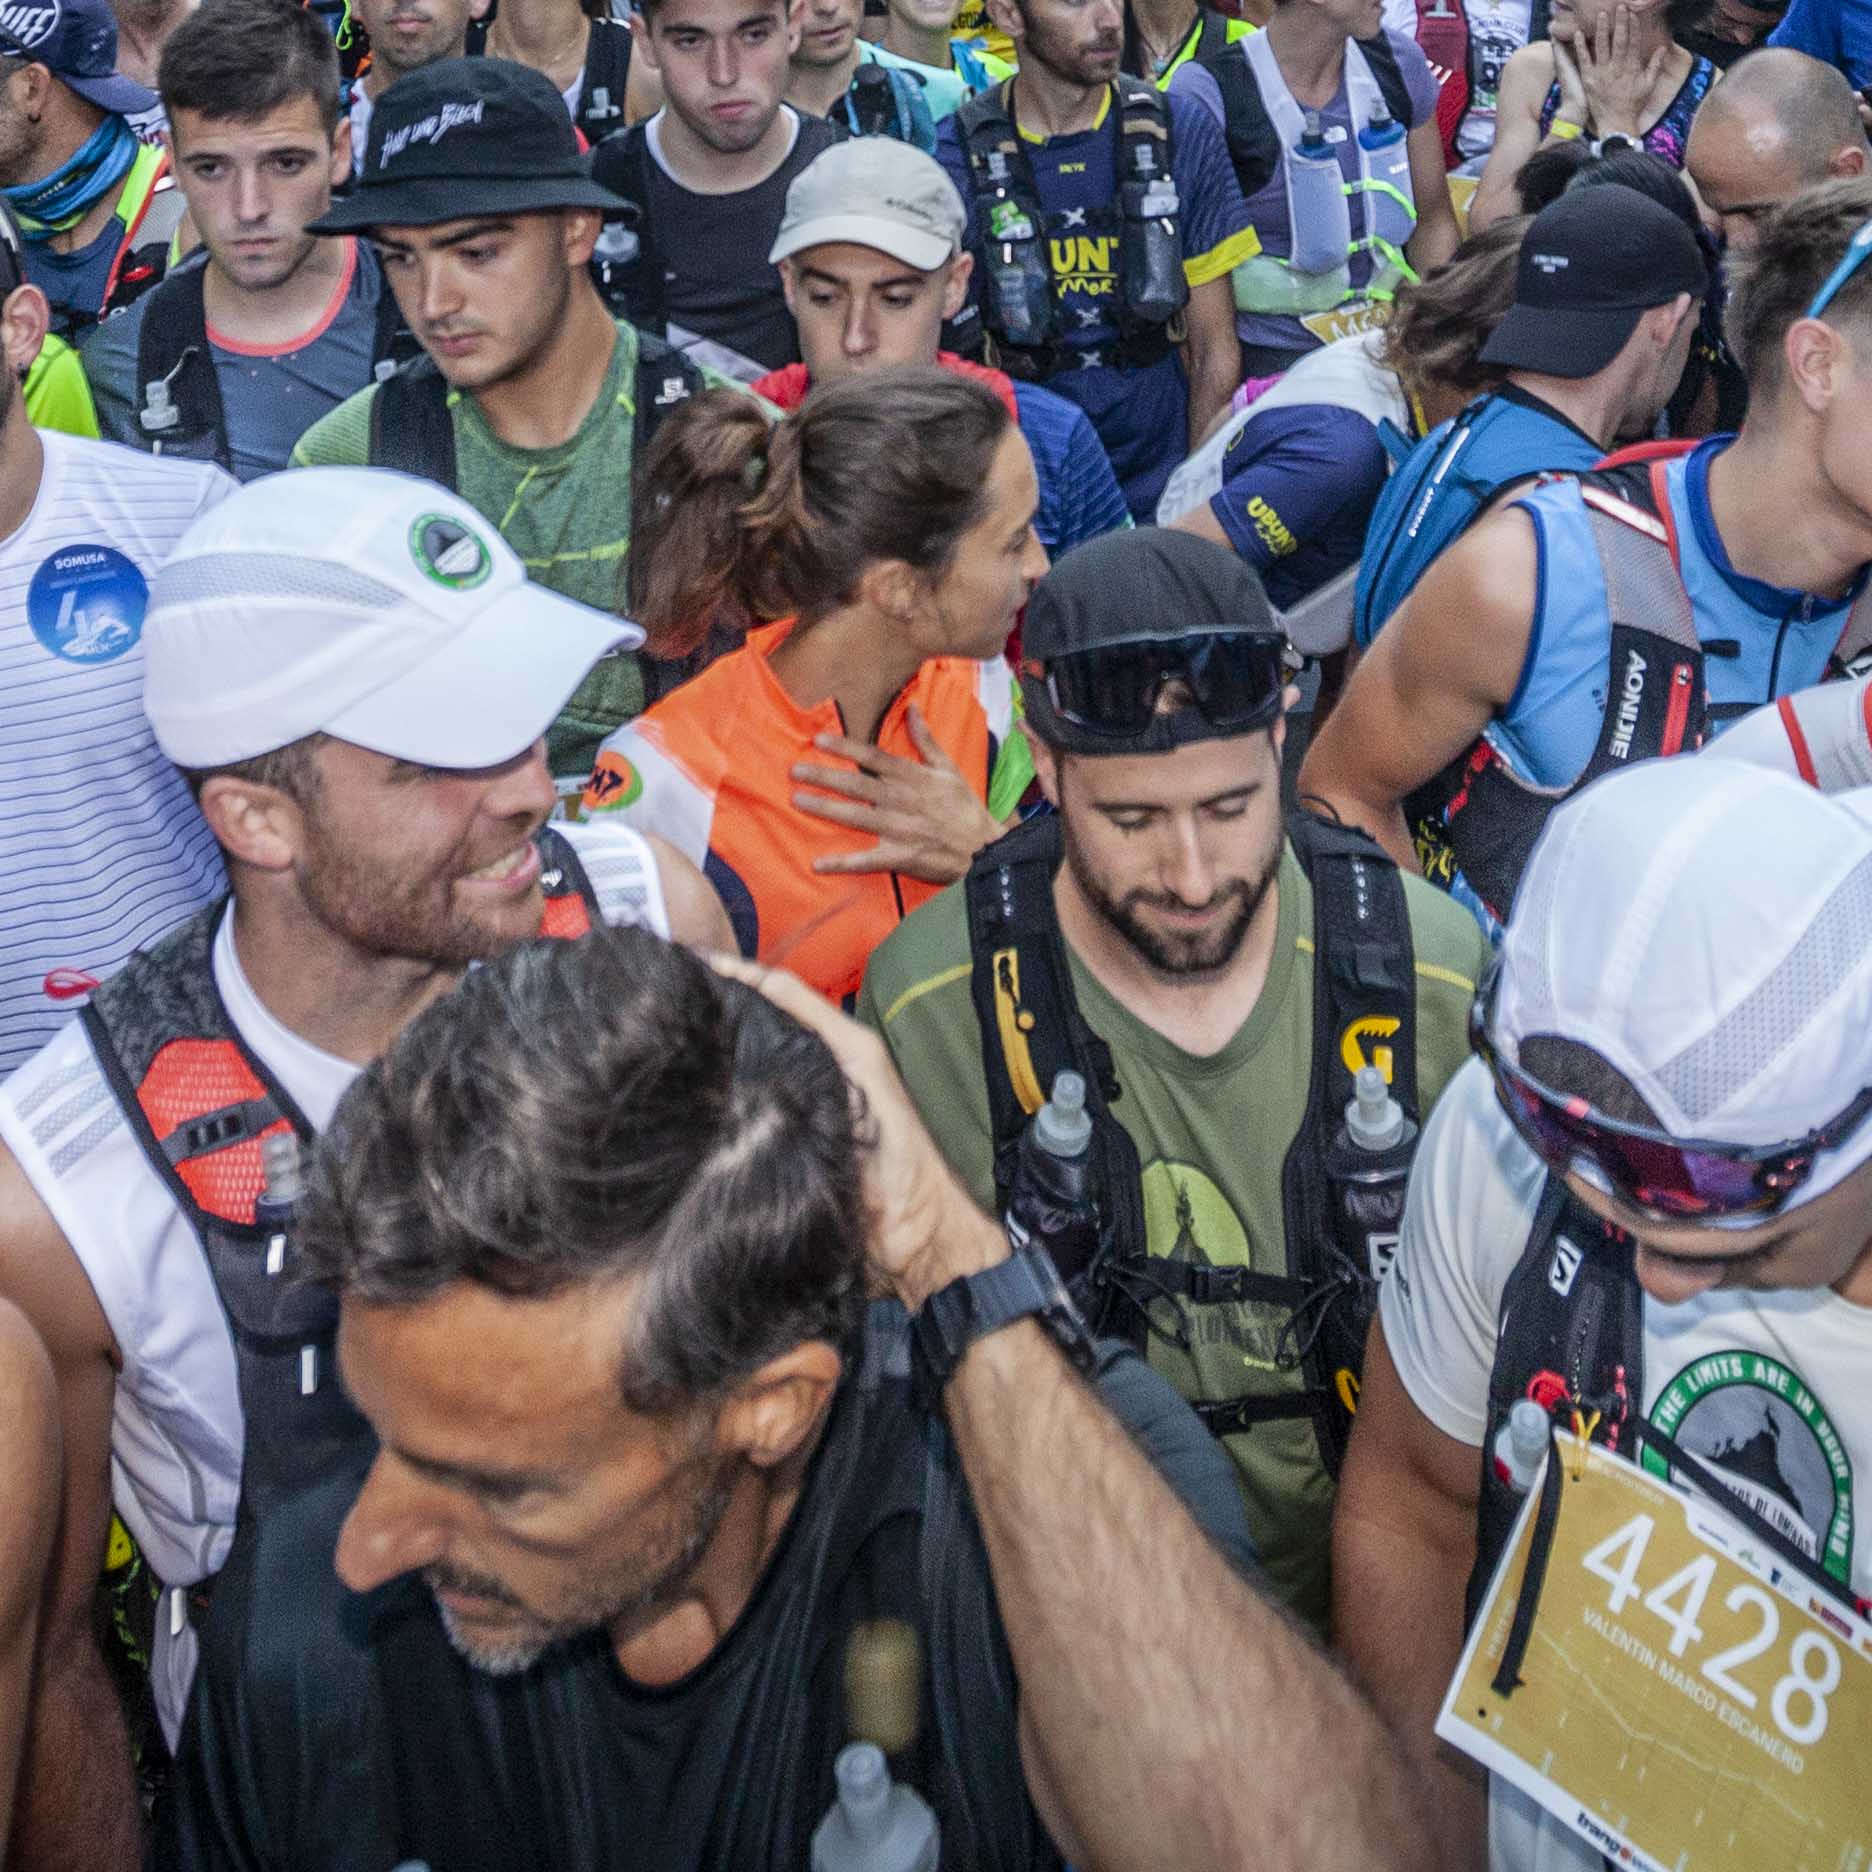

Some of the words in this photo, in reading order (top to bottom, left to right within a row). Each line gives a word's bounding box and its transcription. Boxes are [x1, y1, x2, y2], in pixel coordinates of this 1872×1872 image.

[1610, 648, 1647, 759] AONIJIE
[1653, 1387, 1689, 1432] THE
[1685, 1356, 1747, 1405] LIMITS
[1749, 1357, 1791, 1390] ARE
[1793, 1388, 1816, 1414] IN
[1583, 1513, 1842, 1746] 4428
[1657, 1655, 1719, 1712] MARCO
